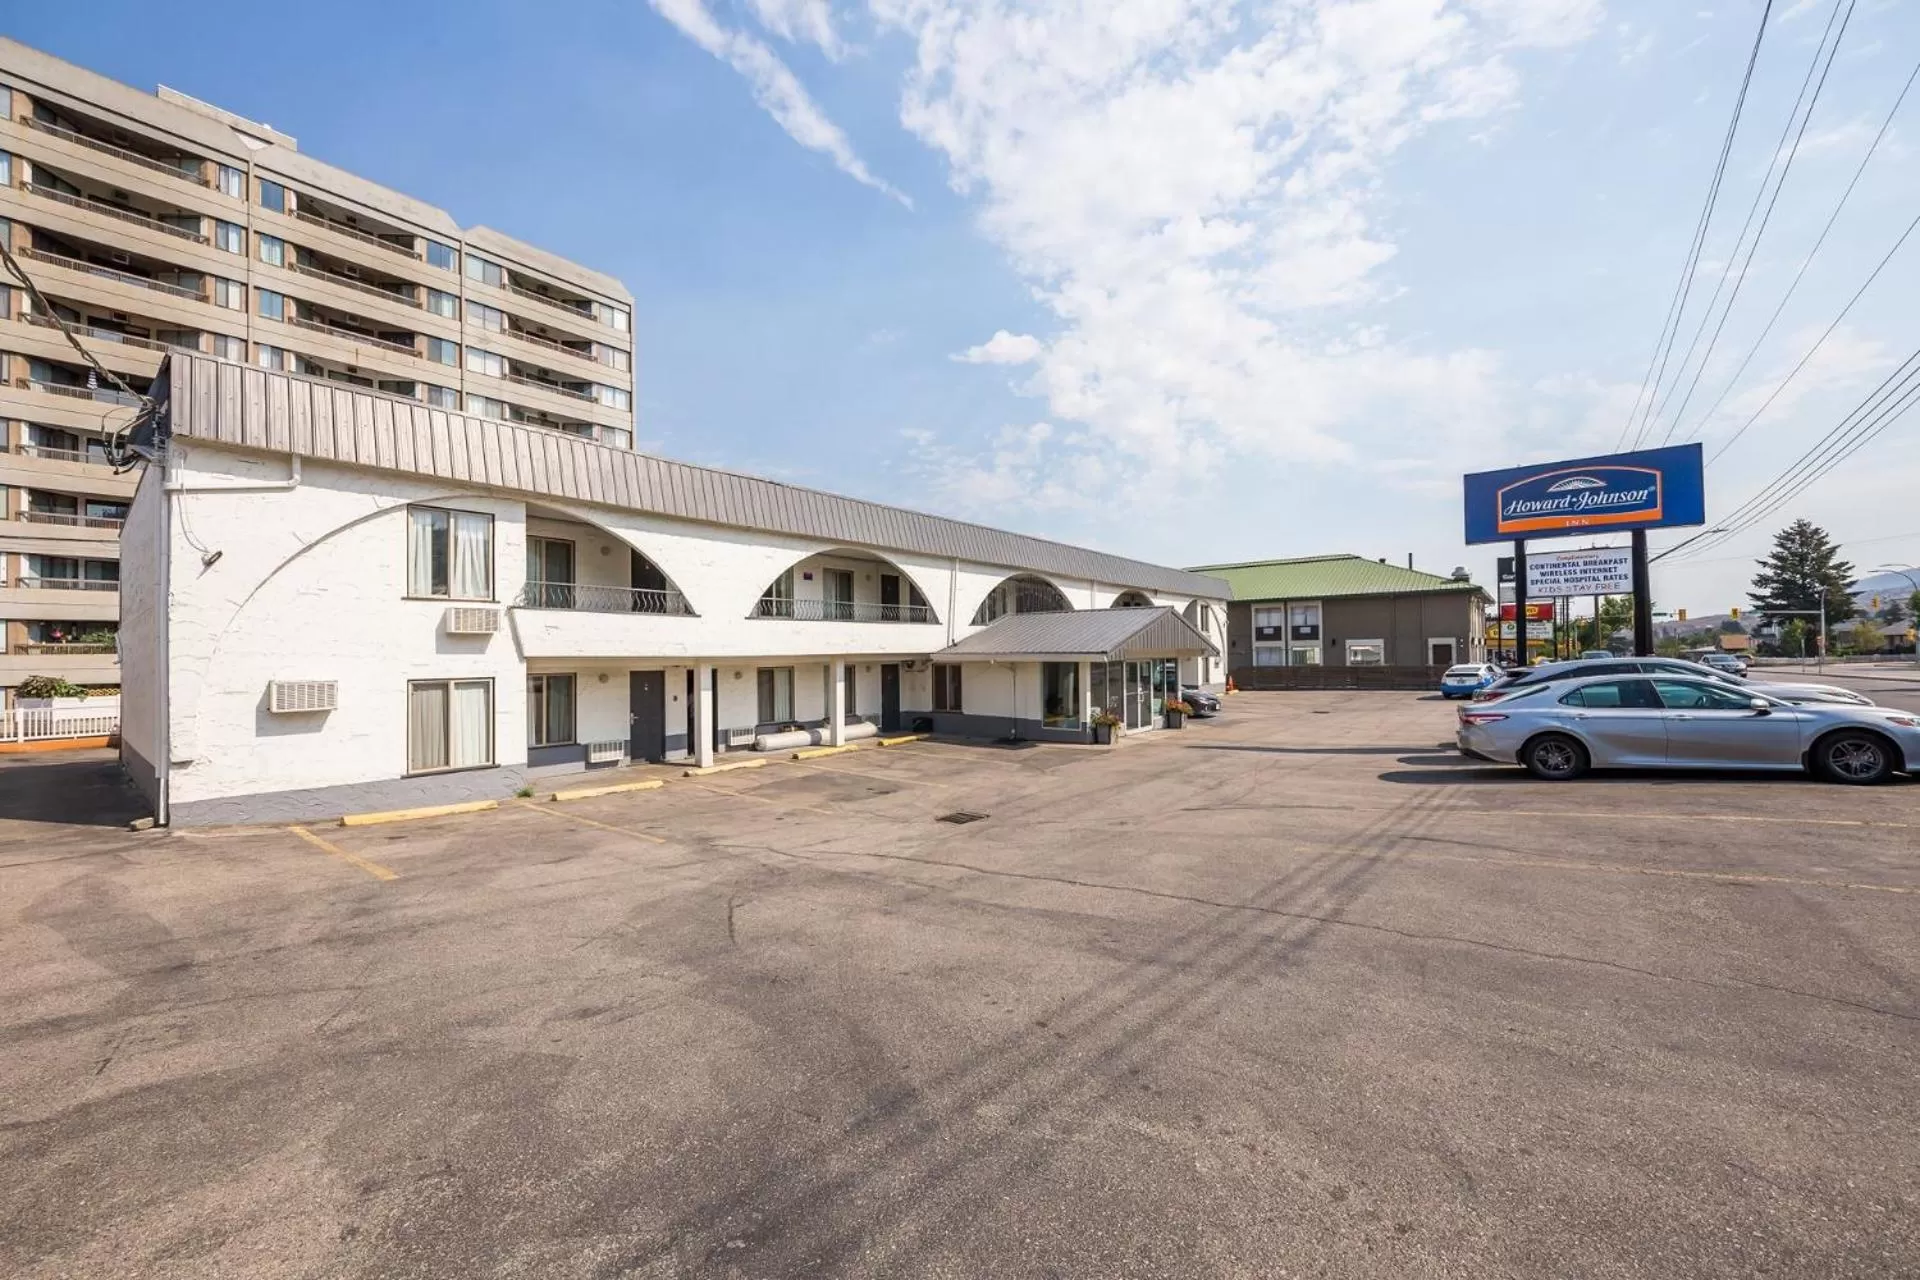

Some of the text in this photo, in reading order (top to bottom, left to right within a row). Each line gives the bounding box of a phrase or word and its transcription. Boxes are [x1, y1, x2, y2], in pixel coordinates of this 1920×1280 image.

[1503, 490, 1648, 516] Howard Johnson
[1529, 558, 1628, 570] CONTINENTAL BREAKFAST
[1540, 566, 1618, 577] WIRELESS INTERNET
[1530, 573, 1629, 586] SPECIAL HOSPITAL RATES
[1567, 583, 1592, 592] STAY
[1595, 582, 1621, 591] FREE
